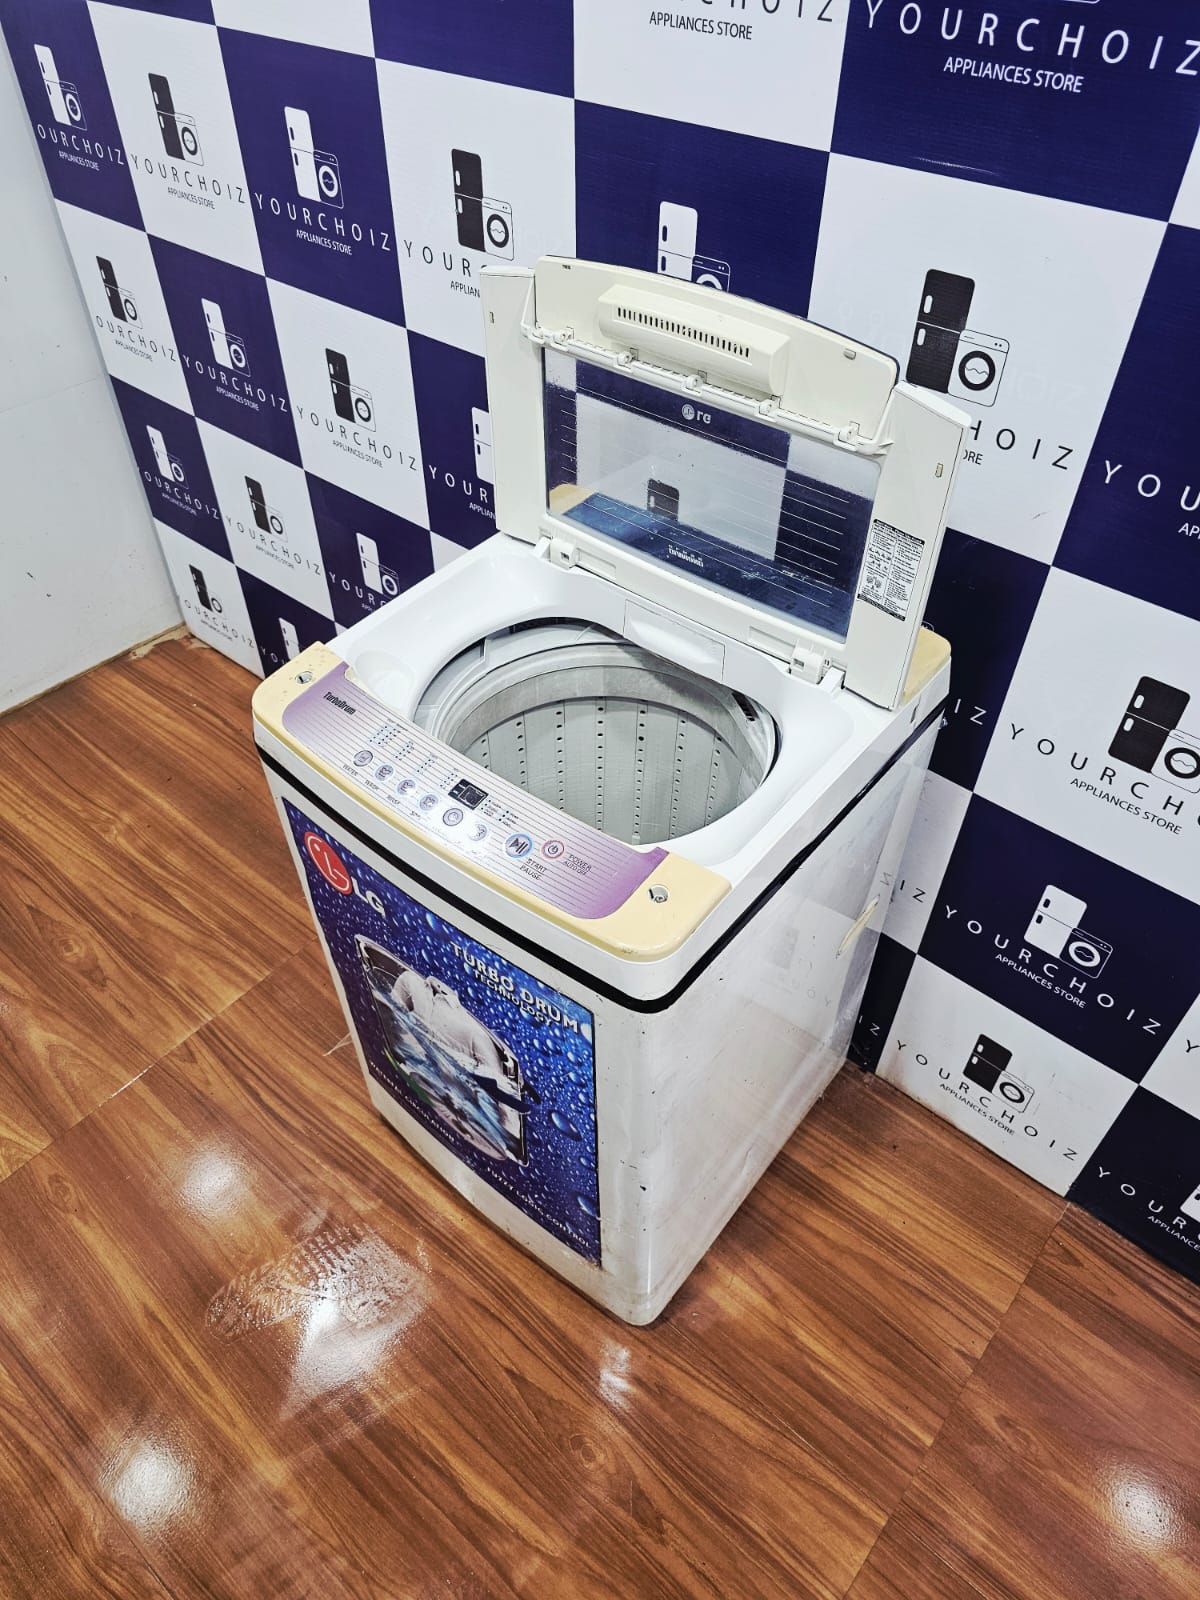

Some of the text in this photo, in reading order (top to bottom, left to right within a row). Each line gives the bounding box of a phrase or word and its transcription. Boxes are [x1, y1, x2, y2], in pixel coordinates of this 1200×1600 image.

[650, 11, 752, 40] APPLIANCES STORE
[866, 0, 1200, 75] YOURCHOIZ
[944, 56, 1084, 93] APPLIANCES STORE
[130, 153, 246, 204] YOURCHOIZ
[255, 192, 391, 251] YOURCHOIZ
[296, 229, 352, 255] APPLIANCES STORE
[183, 355, 288, 412] YOURCHOIZ
[297, 406, 418, 471] YOURCHOIZ
[226, 517, 322, 575] YOURCHOIZ
[1010, 723, 1200, 827] YOURCH
[1070, 778, 1183, 835] APPLIANCES STORE
[520, 865, 542, 880] PAUSE
[526, 858, 547, 873] START
[569, 854, 592, 871] POWER
[351, 879, 387, 918] LG
[450, 941, 581, 1034] TURBO DRUM
[473, 969, 553, 1027] TECHNOLOGY
[945, 904, 1162, 1036] YOURCHOIZ
[994, 952, 1087, 1009] APPLIANCES STORE
[896, 1039, 1077, 1161] YOURCHOIZ
[939, 1083, 1016, 1136] APPLIANCES STORE
[516, 1190, 544, 1216] LOGIC
[546, 1213, 592, 1249] CONTROL
[1147, 1215, 1200, 1253] APPLIANCE
